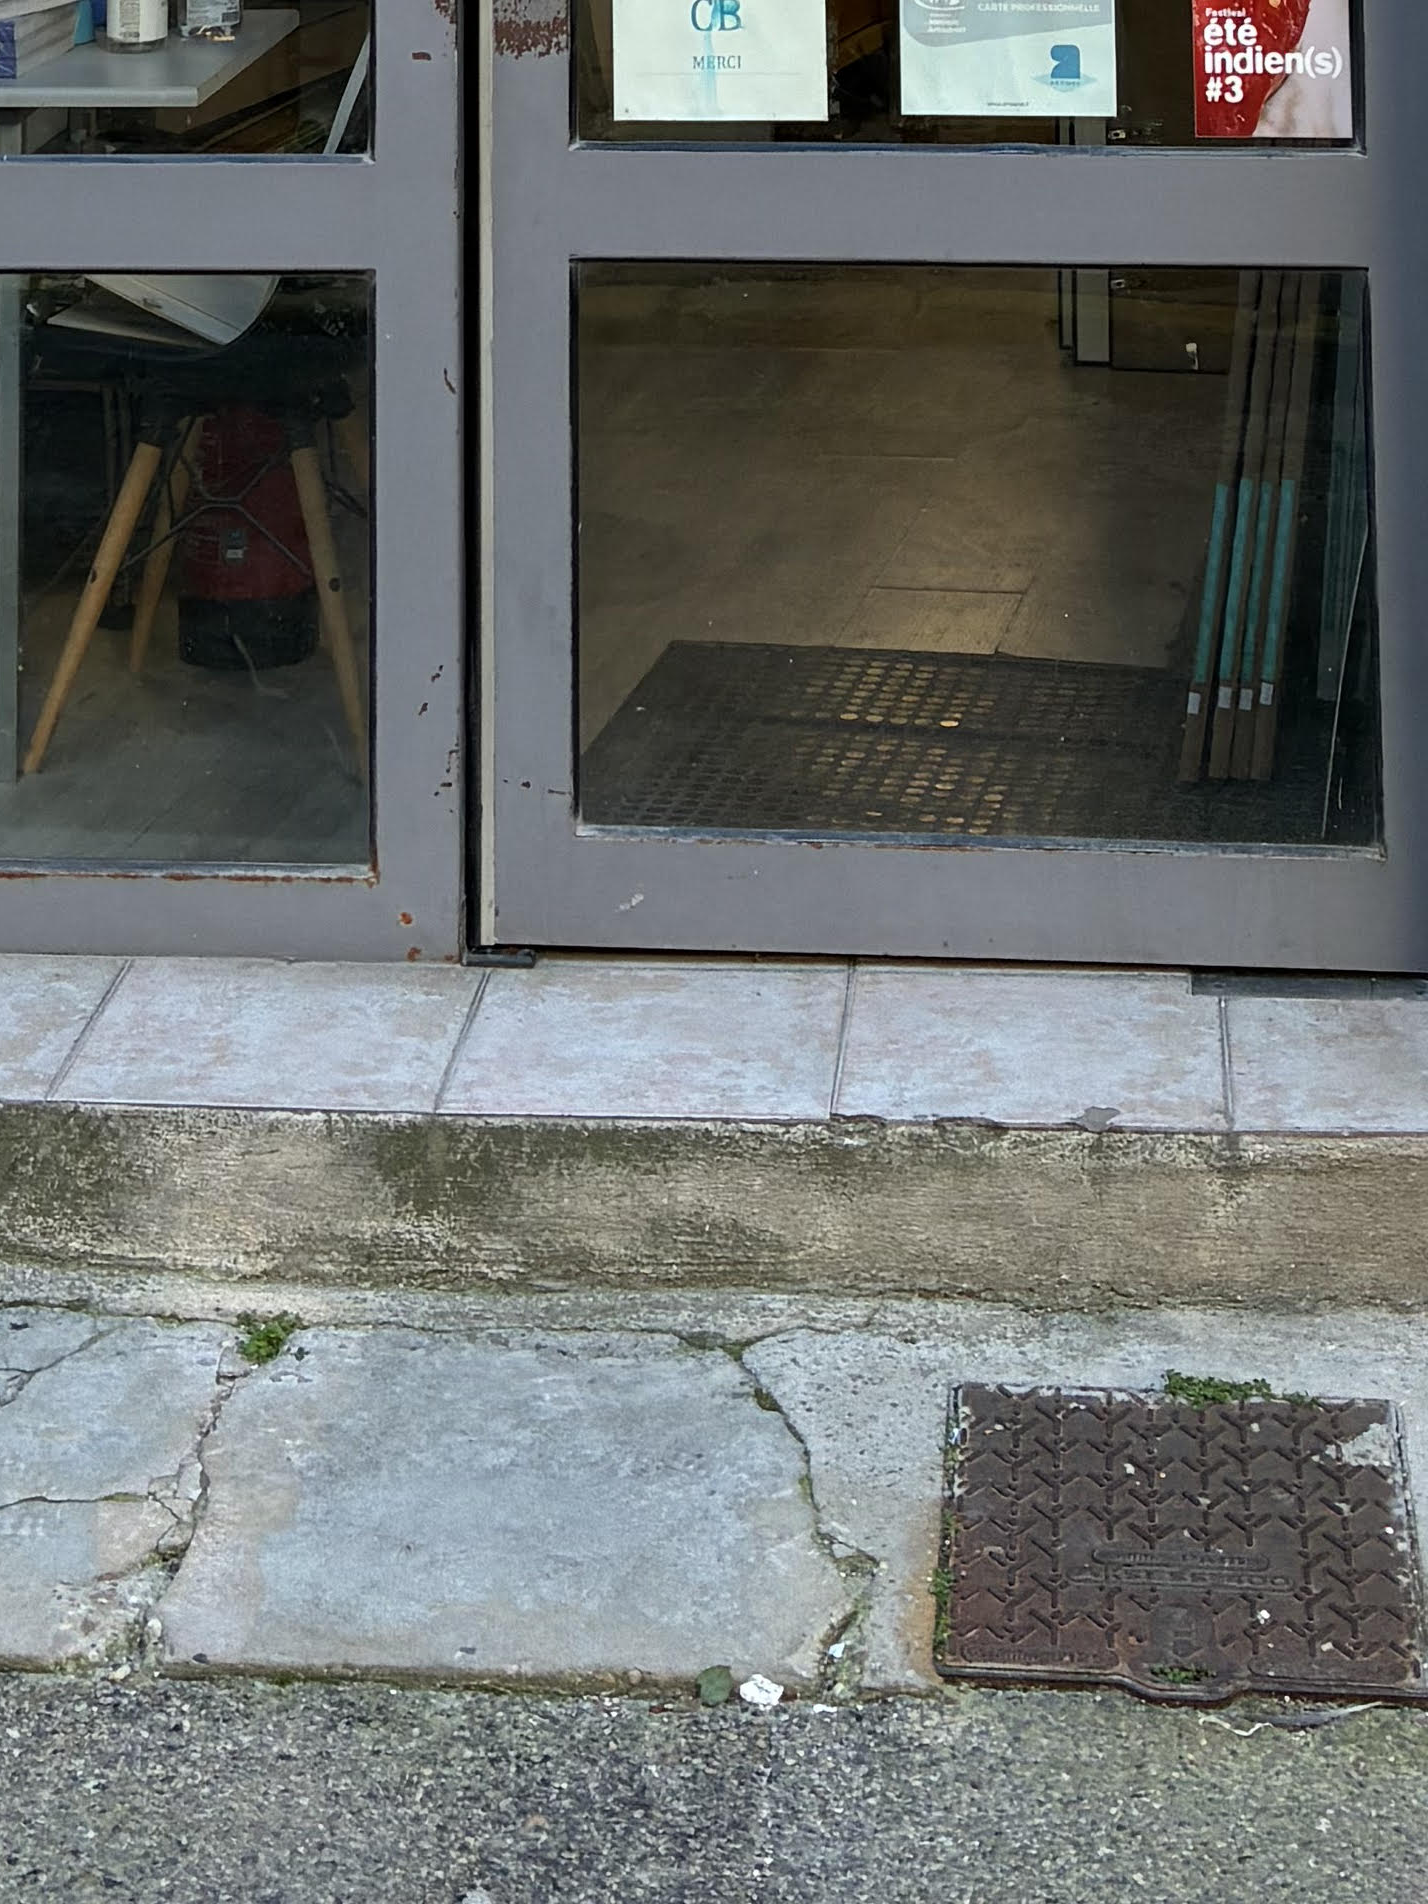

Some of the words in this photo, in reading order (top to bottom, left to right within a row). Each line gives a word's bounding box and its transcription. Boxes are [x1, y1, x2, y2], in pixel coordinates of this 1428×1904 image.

[1205, 7, 1247, 18] Festival
[1203, 17, 1258, 46] été
[692, 54, 742, 70] MERCI
[1204, 45, 1343, 80] indien(s)
[1205, 75, 1244, 103] #3
